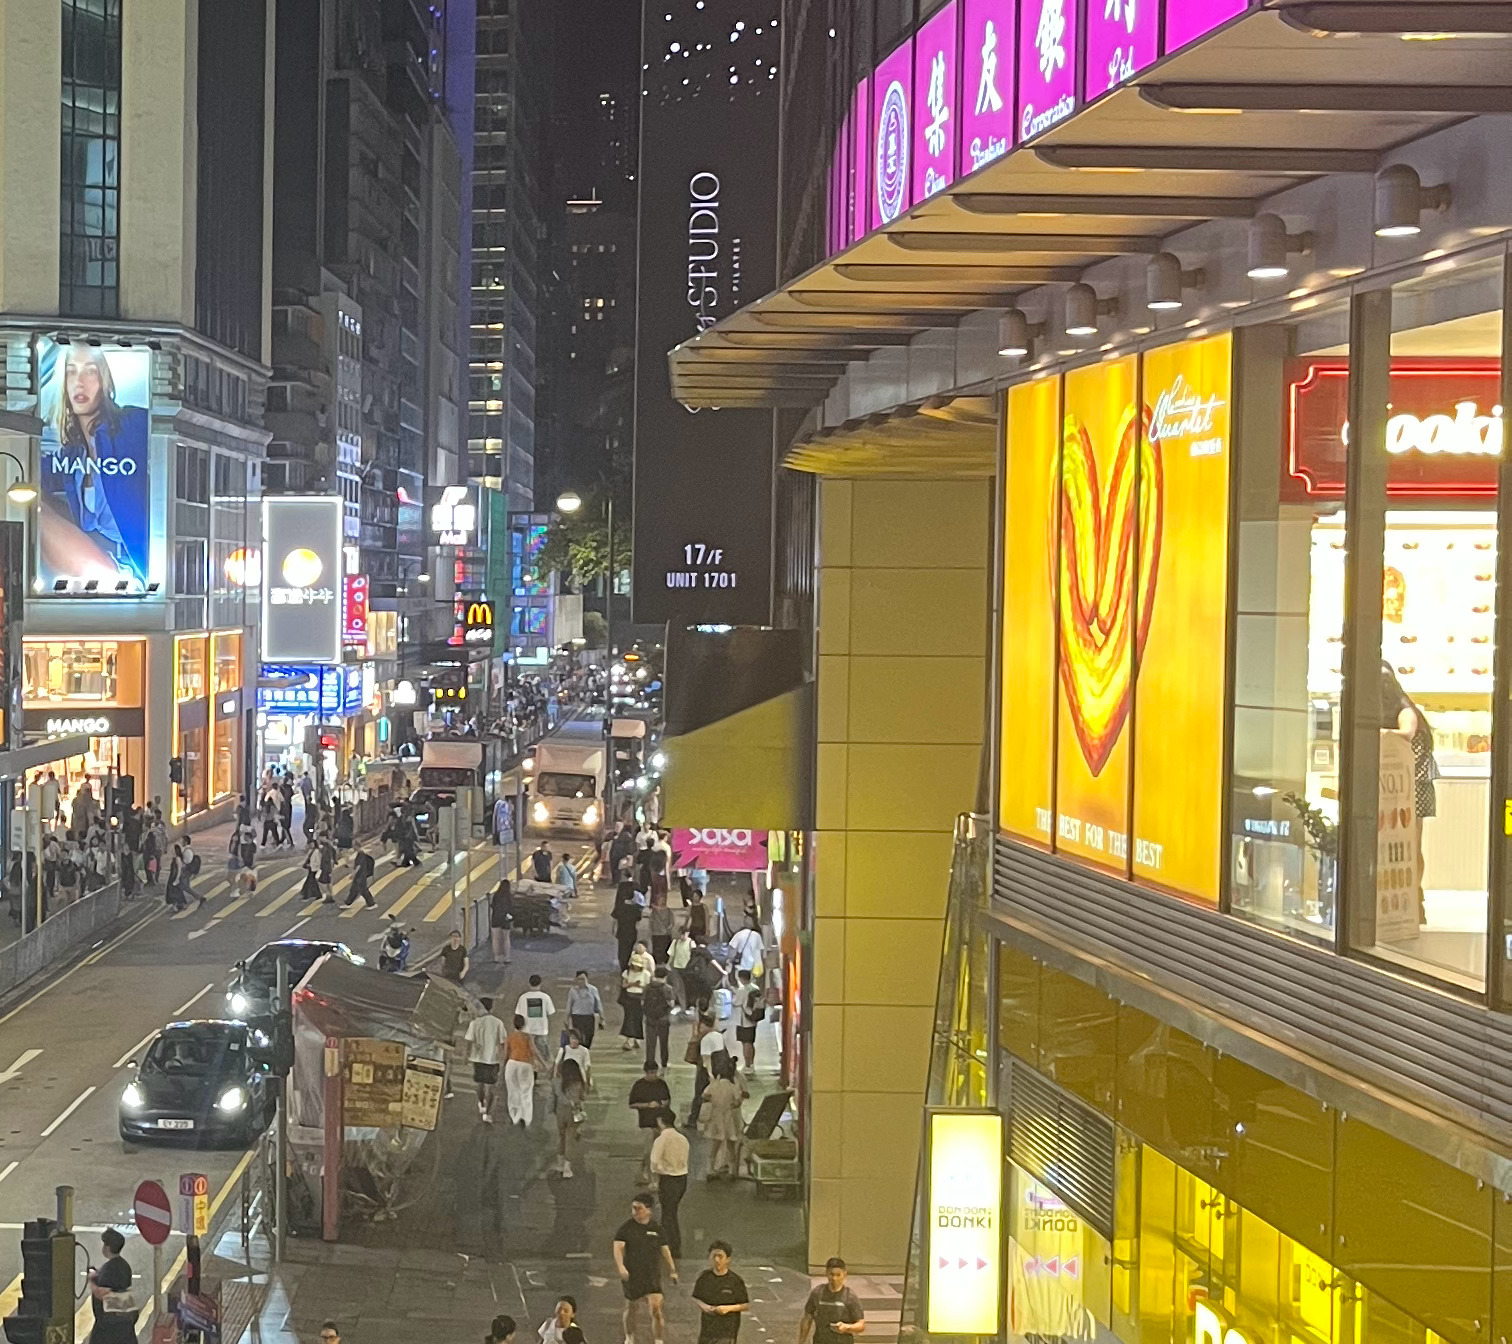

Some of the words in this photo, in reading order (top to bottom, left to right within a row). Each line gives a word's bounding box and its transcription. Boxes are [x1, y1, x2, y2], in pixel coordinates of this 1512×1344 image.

[688, 172, 720, 307] STUDIO
[51, 456, 138, 476] MANGO
[684, 543, 724, 565] 17/F
[666, 572, 698, 588] UNIT
[703, 572, 736, 588] 1701
[47, 716, 110, 734] MANGO
[1059, 813, 1081, 843] BEST
[1085, 822, 1104, 851] FOR
[1136, 837, 1163, 869] BEST
[938, 1215, 992, 1229] DONKI
